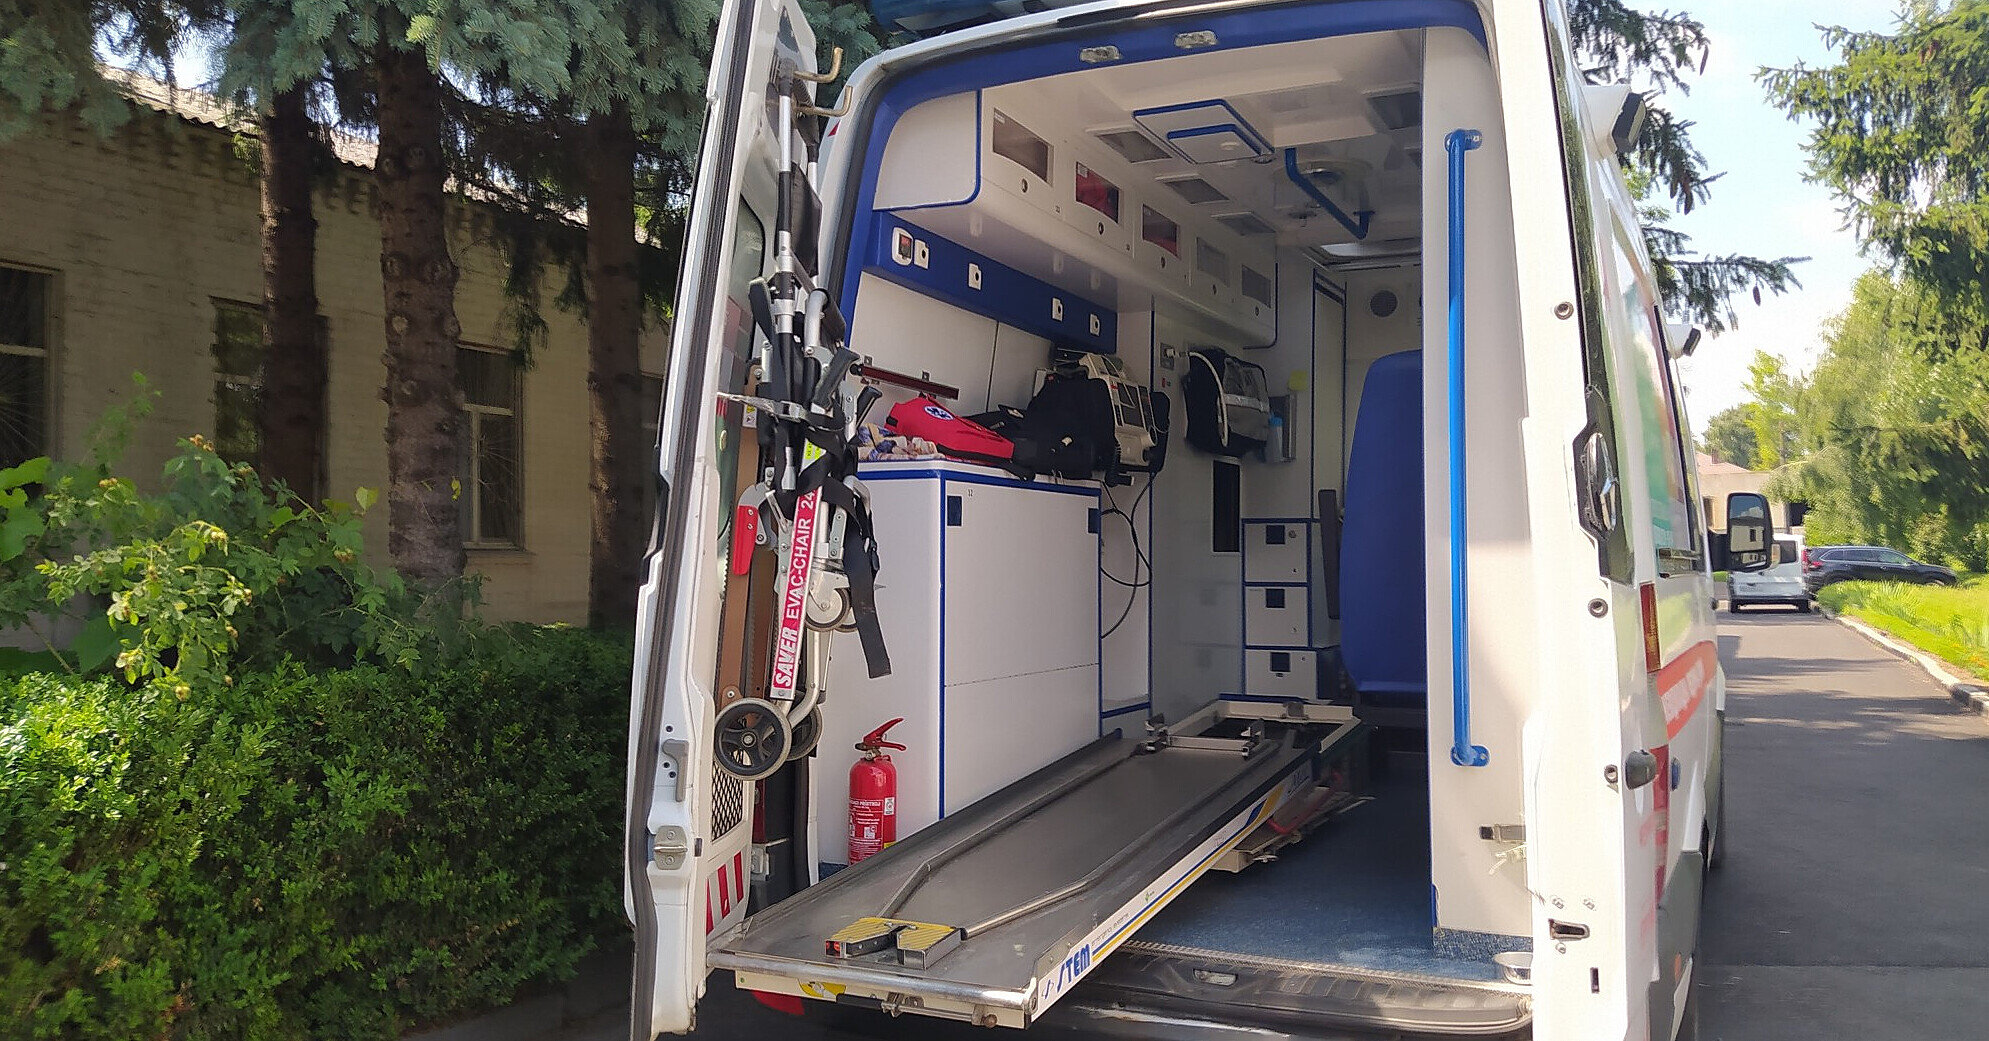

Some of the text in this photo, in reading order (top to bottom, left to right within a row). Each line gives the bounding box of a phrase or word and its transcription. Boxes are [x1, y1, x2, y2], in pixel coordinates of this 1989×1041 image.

[775, 490, 816, 687] SAVER EVAC-CHAIR 24
[1056, 943, 1091, 993] STEM
